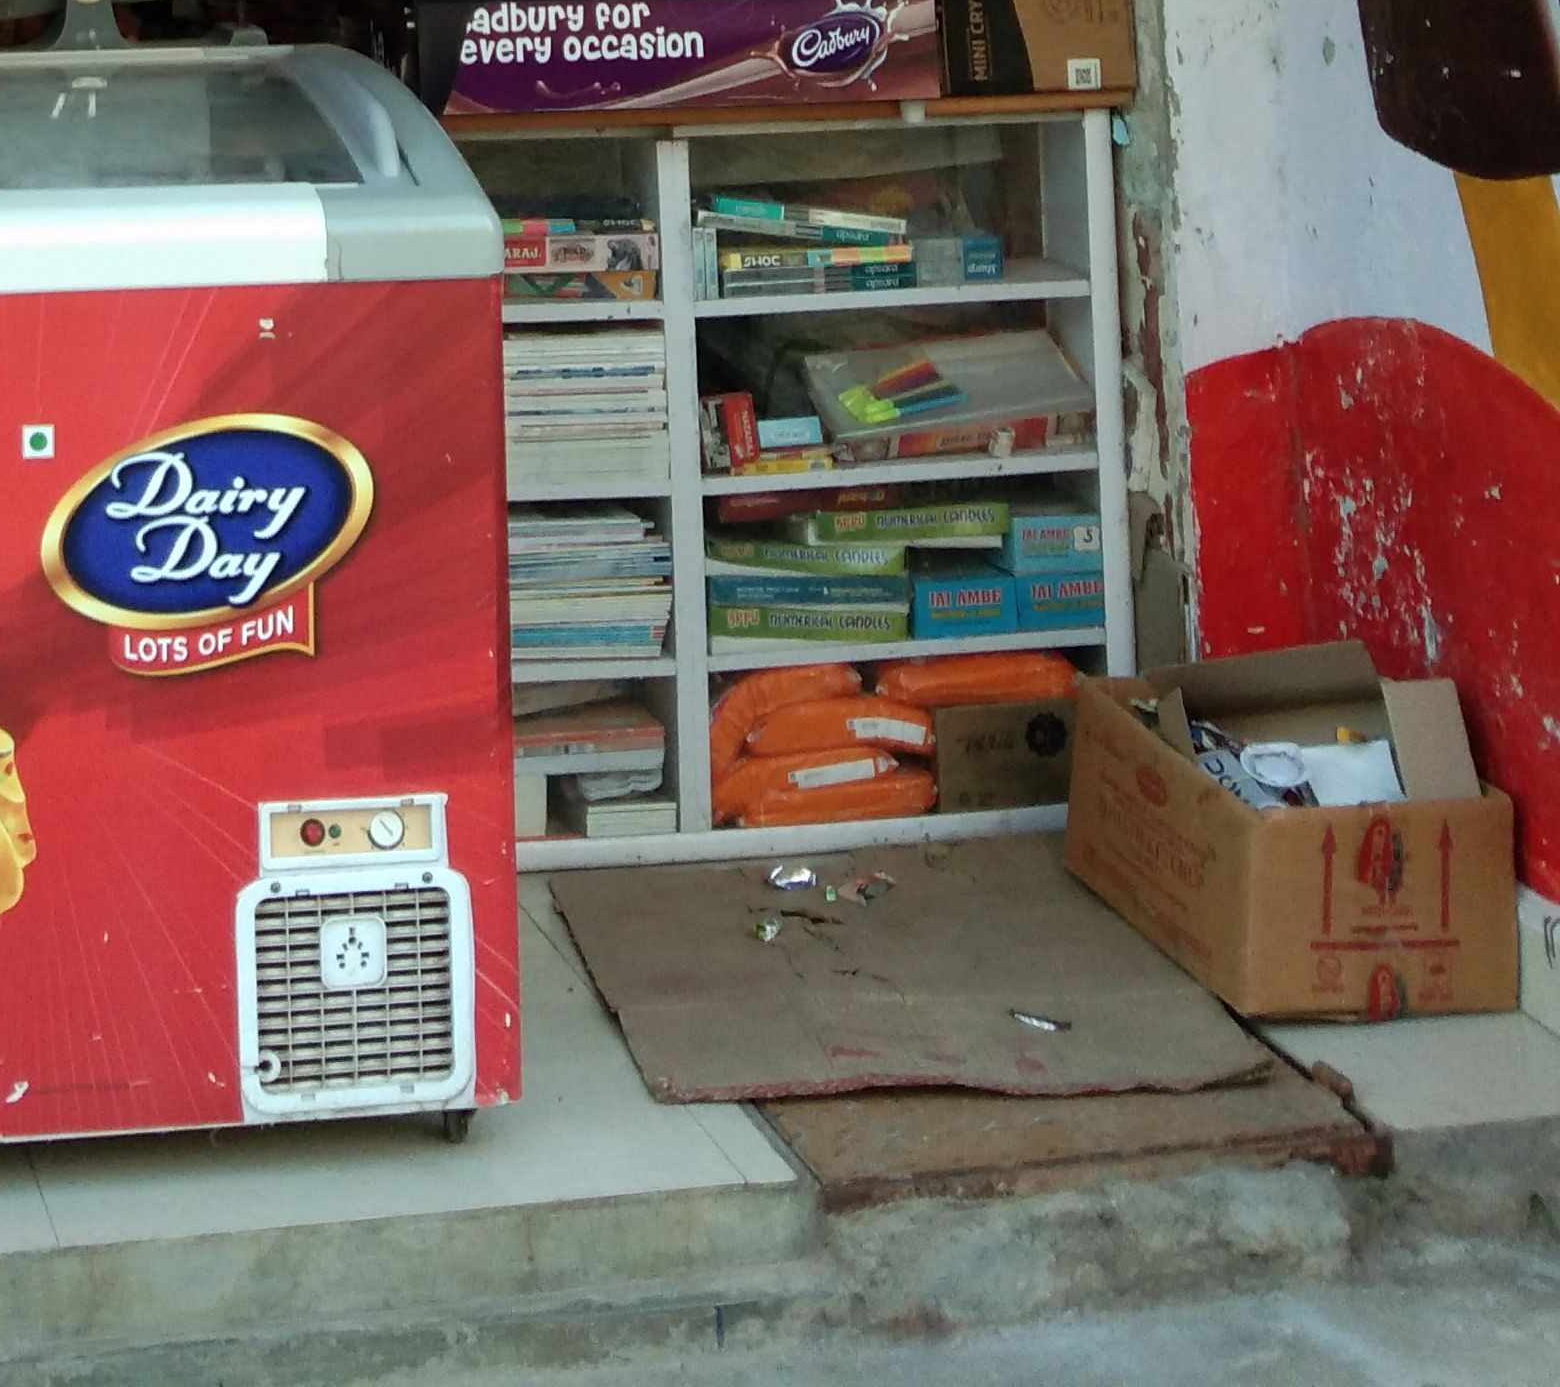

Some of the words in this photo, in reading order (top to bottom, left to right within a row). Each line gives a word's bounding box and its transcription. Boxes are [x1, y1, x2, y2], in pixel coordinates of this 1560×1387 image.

[466, 1, 584, 35] adbury
[595, 2, 651, 30] for
[460, 34, 552, 65] every
[563, 25, 705, 62] occasion
[792, 26, 870, 68] Cadbury
[972, 39, 989, 82] MINI
[107, 453, 305, 538] Dairy
[131, 517, 280, 605] Day
[928, 591, 952, 608] JAI
[956, 587, 1002, 606] AMBE
[1031, 583, 1052, 601] JAI
[124, 635, 188, 664] LOTS
[198, 629, 233, 657] OF
[242, 605, 294, 646] FUN
